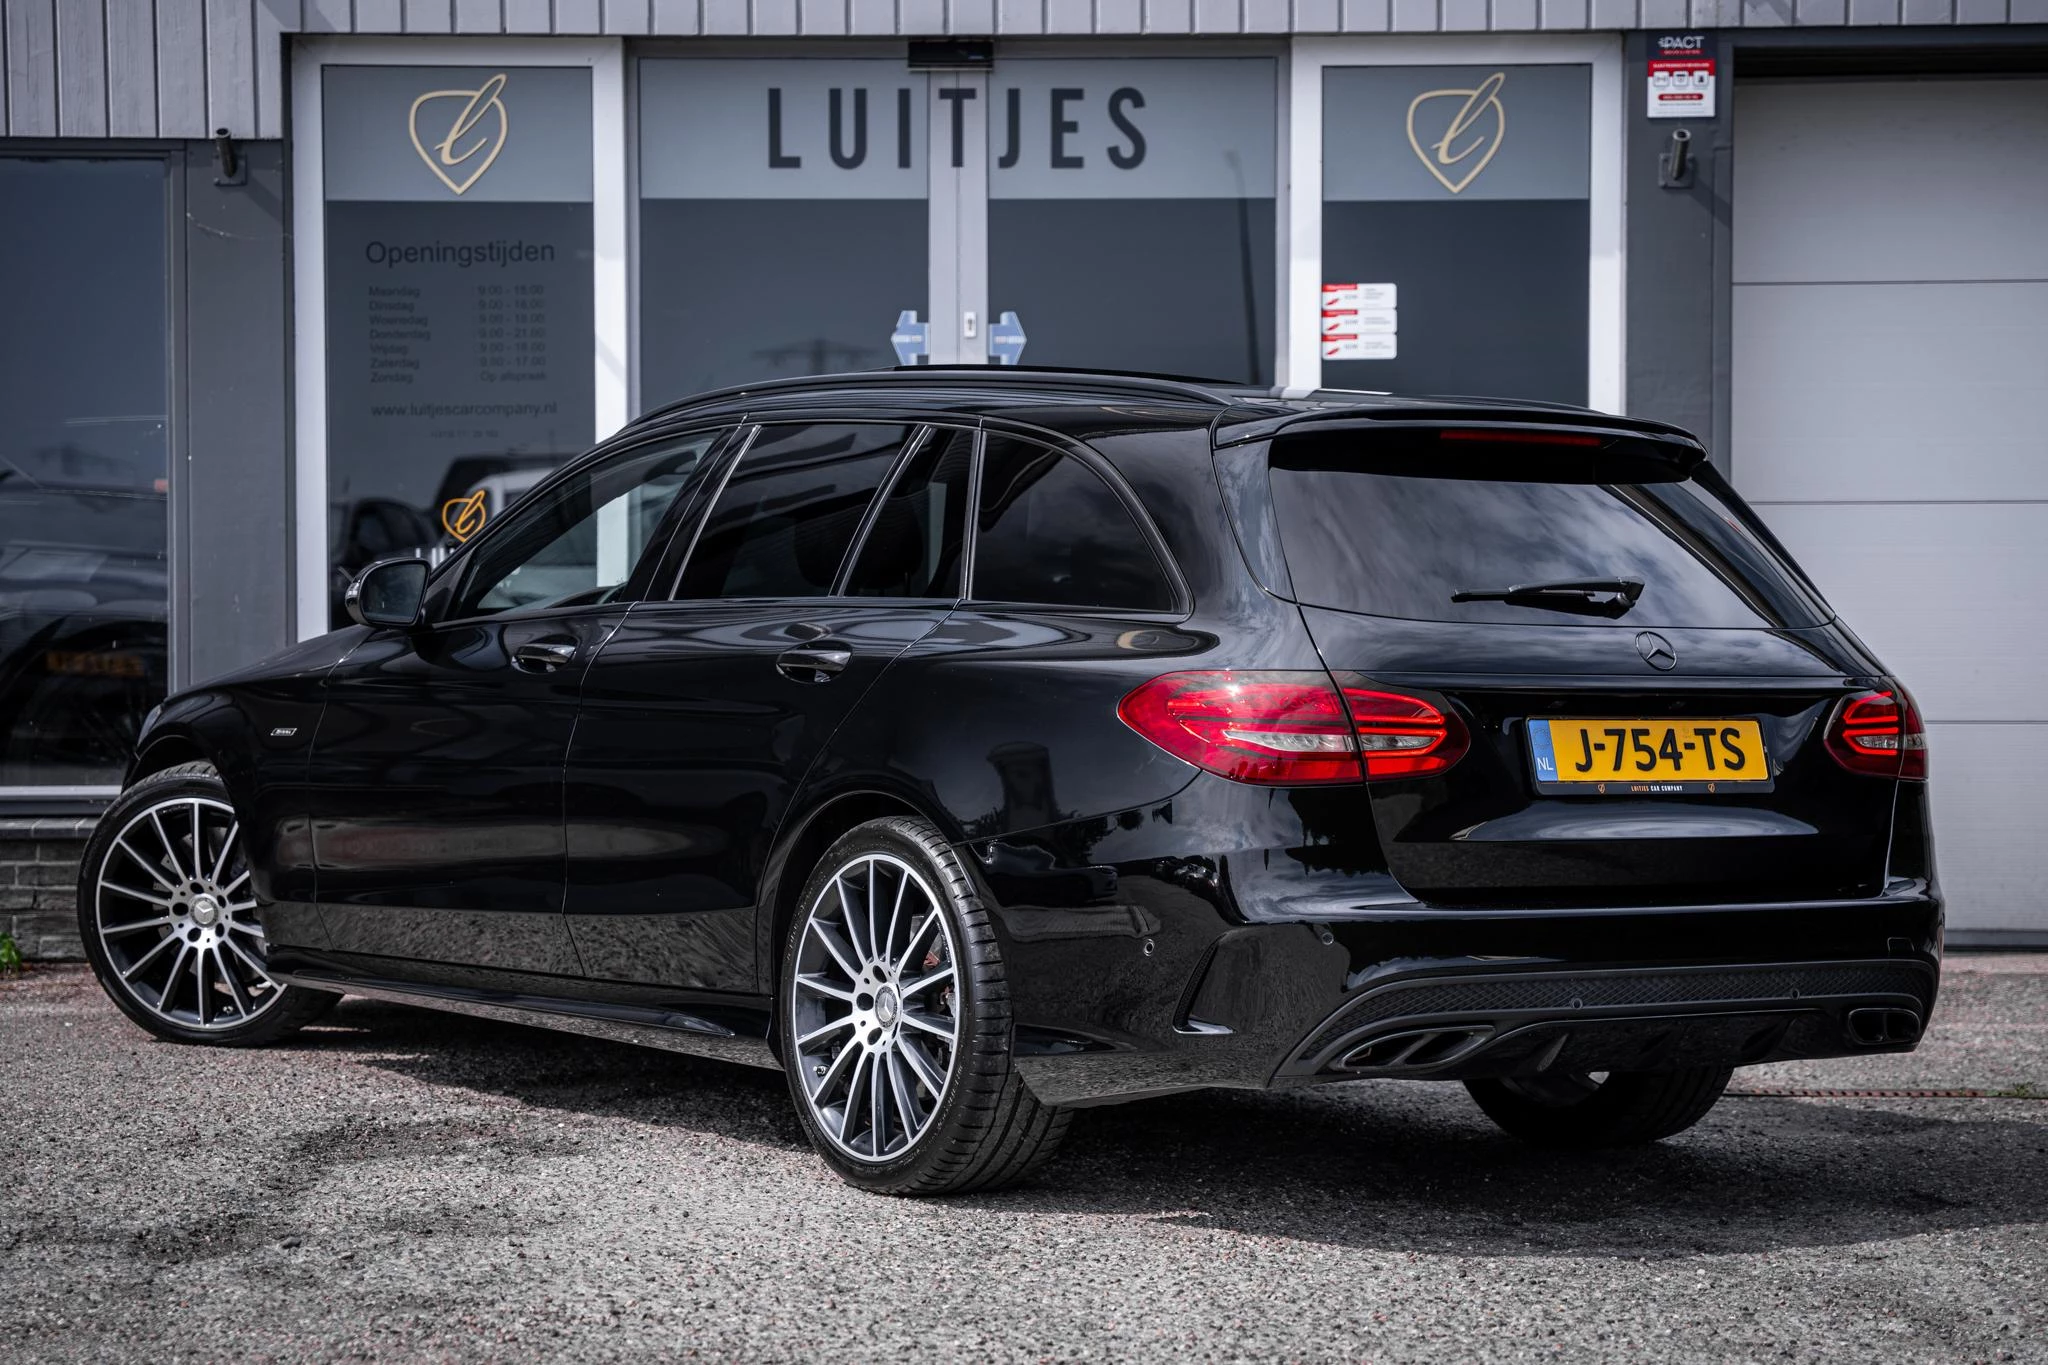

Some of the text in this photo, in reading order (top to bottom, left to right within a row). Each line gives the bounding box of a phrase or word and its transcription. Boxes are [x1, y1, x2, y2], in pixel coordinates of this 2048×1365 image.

[768, 86, 1147, 170] LUITJES
[366, 240, 555, 268] Openingstijden
[368, 286, 420, 298] Maandag
[369, 300, 415, 313] Dinsdag
[369, 315, 428, 327] Woensdag
[369, 329, 431, 342] Donderdag
[370, 343, 409, 356] Vrijdag
[370, 357, 420, 370] Zaterdag
[370, 372, 414, 384] Zondag
[370, 401, 557, 418] www.luitjescarcompany.nl
[1575, 728, 1746, 773] J-754-TS
[1537, 757, 1554, 771] NL
